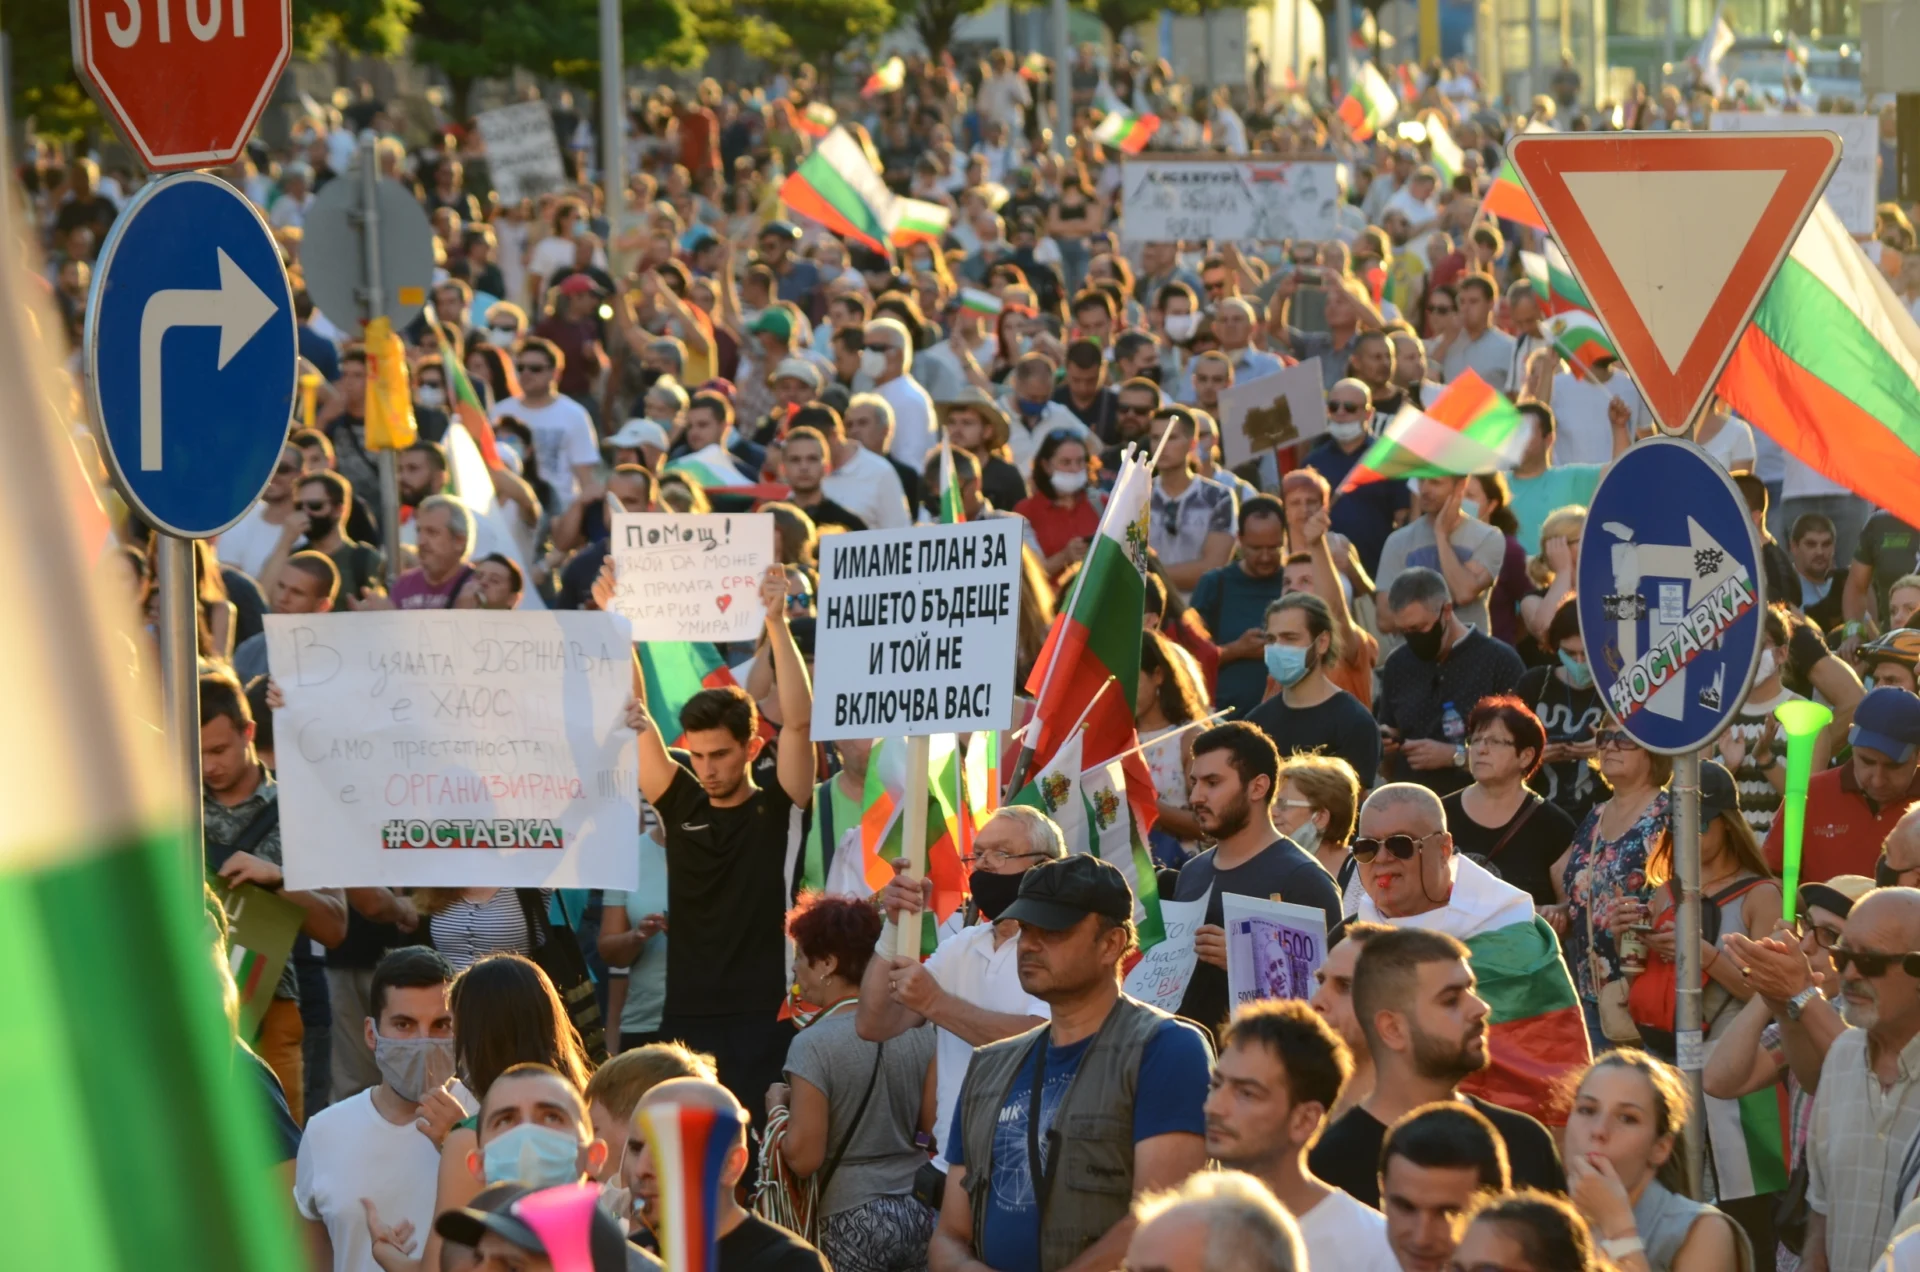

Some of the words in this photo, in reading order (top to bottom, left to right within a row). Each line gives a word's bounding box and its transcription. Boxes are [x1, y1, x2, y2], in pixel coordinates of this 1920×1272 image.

[703, 553, 759, 570] МОЖЕ
[833, 541, 912, 580] ИМАМЕ
[917, 536, 977, 573] ПЛАН
[981, 533, 1007, 568] ЗА
[644, 579, 714, 597] ПРИЛАГА
[827, 590, 916, 629] НАШЕТО
[921, 583, 1010, 628] БЪДЕЩЕ
[289, 626, 343, 687] В
[869, 642, 884, 675] И
[889, 631, 931, 674] ТОЙ
[935, 636, 963, 671] НЕ
[1613, 574, 1753, 720] #ОСТАВКА
[430, 688, 513, 720] ХАОС
[835, 687, 939, 727] ВКЛЮЧВА
[944, 683, 992, 720] ВАС!
[384, 818, 561, 849] #ОСТАВКА
